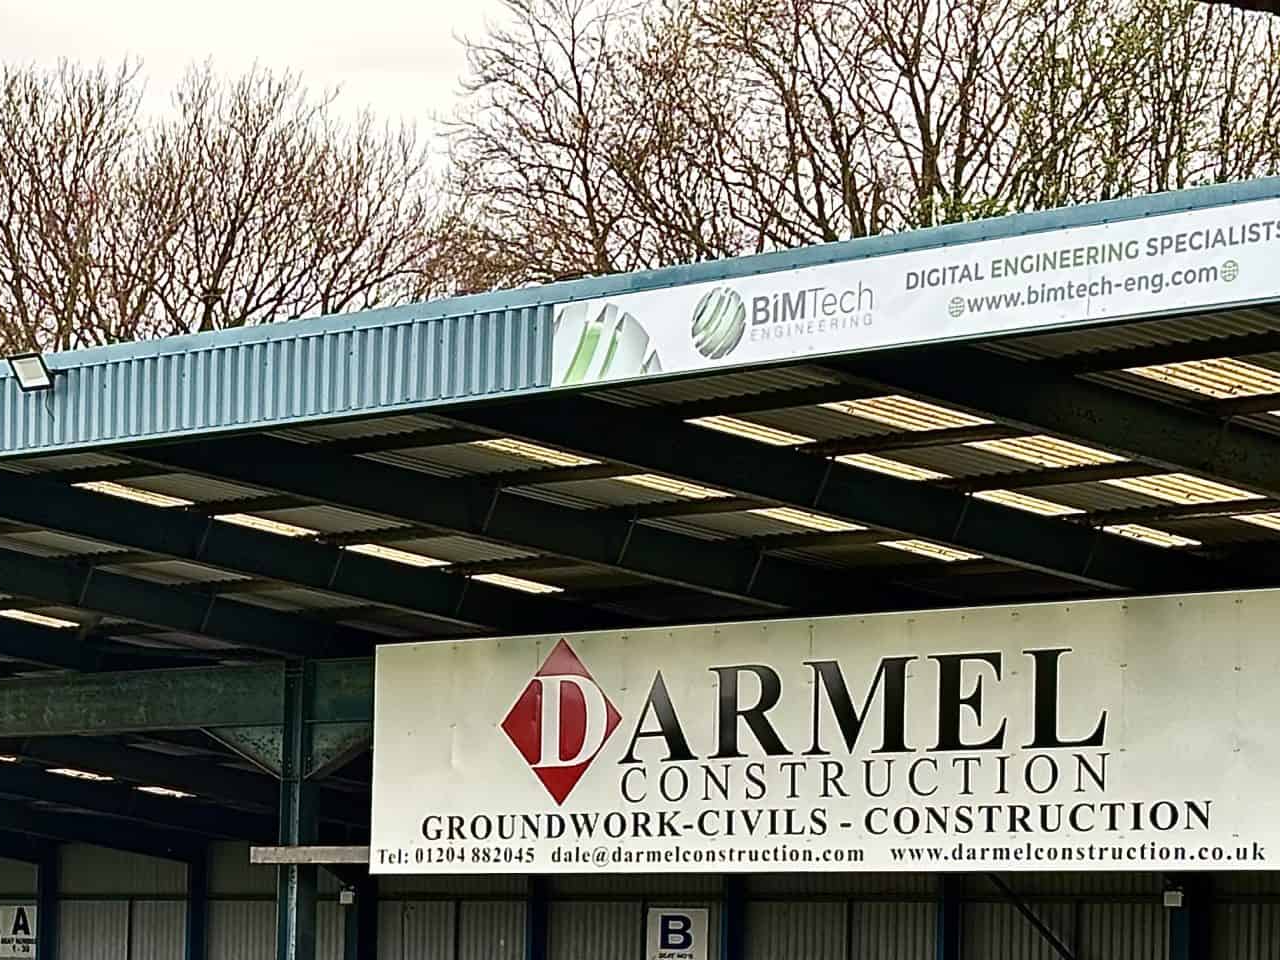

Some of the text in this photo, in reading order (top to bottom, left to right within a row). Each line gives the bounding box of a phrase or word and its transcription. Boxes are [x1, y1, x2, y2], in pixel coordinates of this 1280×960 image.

[906, 263, 984, 290] DIGITAL
[991, 241, 1140, 278] ENGINEERING
[751, 281, 874, 326] BiMTech
[968, 263, 1219, 313] www.bimtech-eng.com
[750, 313, 873, 342] ENGINEERING
[531, 647, 1108, 768] DARMEL
[621, 752, 1110, 802] CONSTRUCTION
[422, 808, 828, 840] GROUNDWORK-CIVILS
[864, 800, 1213, 835] CONSTRUCTION
[378, 841, 1266, 867] Tel: 01204 882045 dale@darmelconstruction.com www.darmelconstruction.co.uk
[11, 907, 31, 935] A
[660, 914, 694, 950] B
